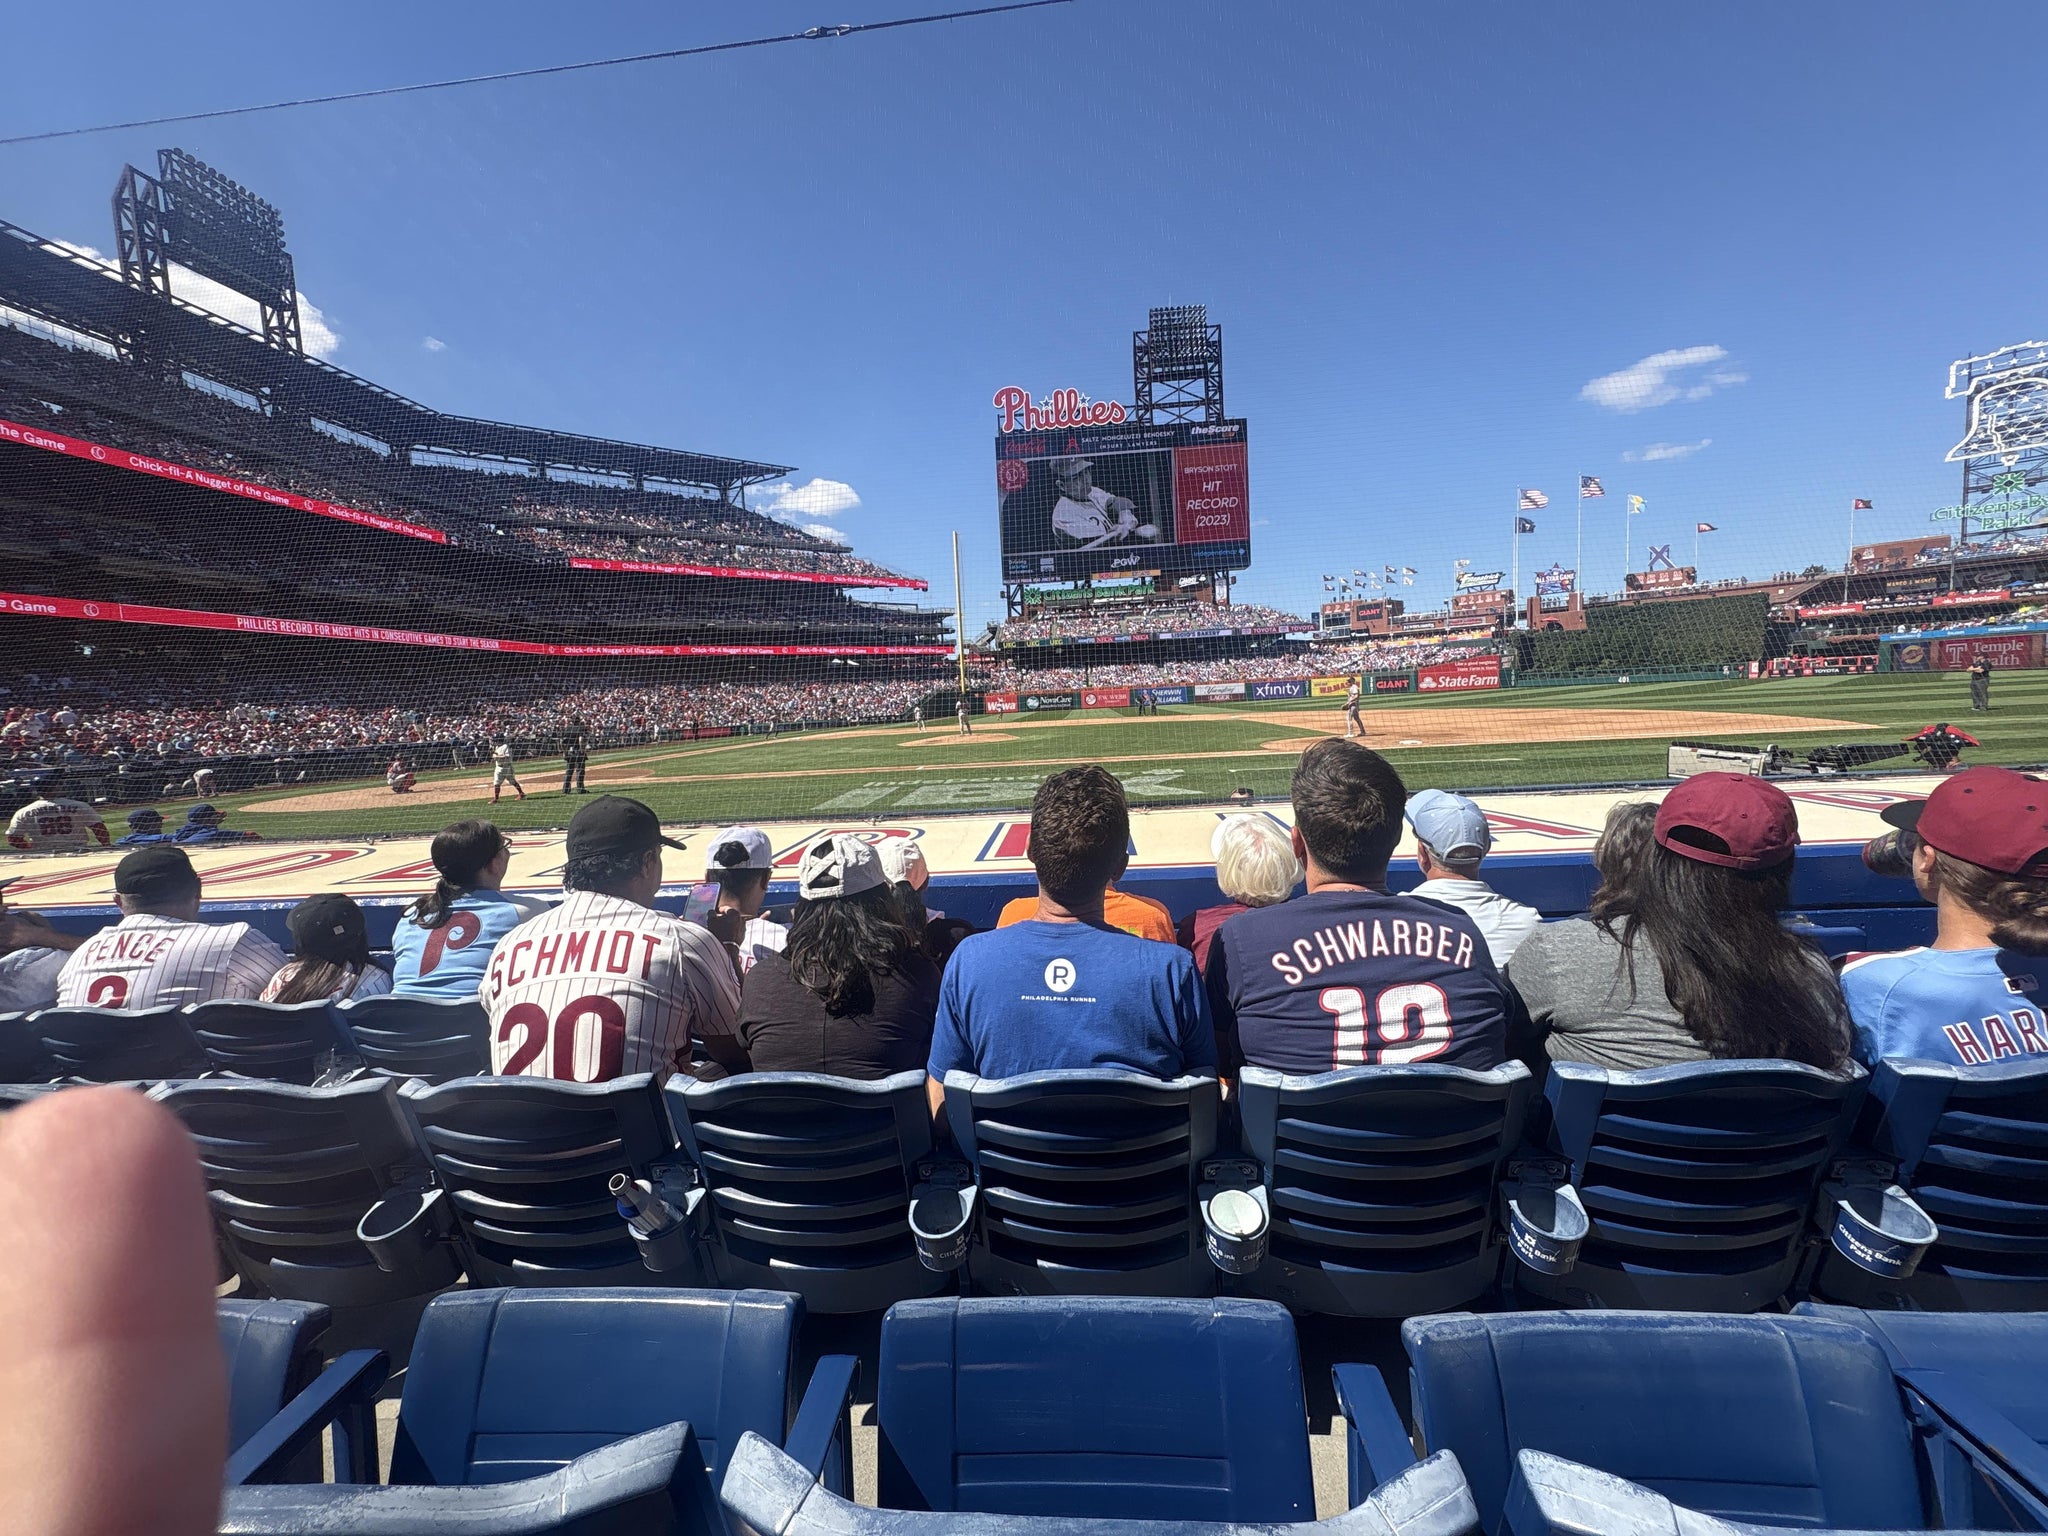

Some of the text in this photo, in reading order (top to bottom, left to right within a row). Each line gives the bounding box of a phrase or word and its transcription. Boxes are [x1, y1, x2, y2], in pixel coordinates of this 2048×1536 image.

[993, 386, 1126, 433] Phillies
[0, 423, 66, 450] he Game
[1191, 424, 1239, 435] theScore
[1184, 464, 1238, 474] BRYSON STOTT
[129, 456, 290, 505] Chick-fil-A Nugget of the Game
[1202, 481, 1222, 492] HIT
[1186, 496, 1239, 510] RECORD
[1934, 500, 2022, 521] Citizens
[328, 506, 369, 522] Chick-fil-A
[370, 516, 394, 529] Nugget
[402, 523, 414, 534] the
[414, 529, 432, 540] Game
[1196, 513, 1231, 528] (2023)
[1982, 512, 2031, 531] Park
[1043, 581, 1157, 600] Citizens Bank Park
[11, 600, 57, 613] Game
[1359, 608, 1381, 616] GIANT
[236, 617, 278, 631] PHILLIES
[279, 621, 313, 634] RECORD
[315, 624, 330, 635] FOR
[332, 626, 353, 637] MOST
[354, 628, 370, 639] HITS
[371, 629, 379, 639] IN
[380, 630, 424, 643] CONSECUTIVE
[1972, 640, 2024, 655] Temple
[1255, 681, 1301, 698] xfinity
[1376, 679, 1409, 689] GIANT
[1438, 674, 1498, 688] State Farm
[1040, 696, 1073, 705] NovaCare
[1151, 688, 1182, 697] SHERWIN
[84, 932, 176, 967] PENCE
[418, 911, 483, 978] P
[1271, 919, 1474, 986] SCHWARBER
[490, 930, 662, 1000] SCHMIDT
[1052, 965, 1069, 984] R
[1318, 981, 1454, 1072] 12
[497, 995, 627, 1083] 20
[1941, 1008, 2048, 1066] HAR
[1839, 1223, 1902, 1266] Citizens Bank
[1849, 1243, 1874, 1263] Park
